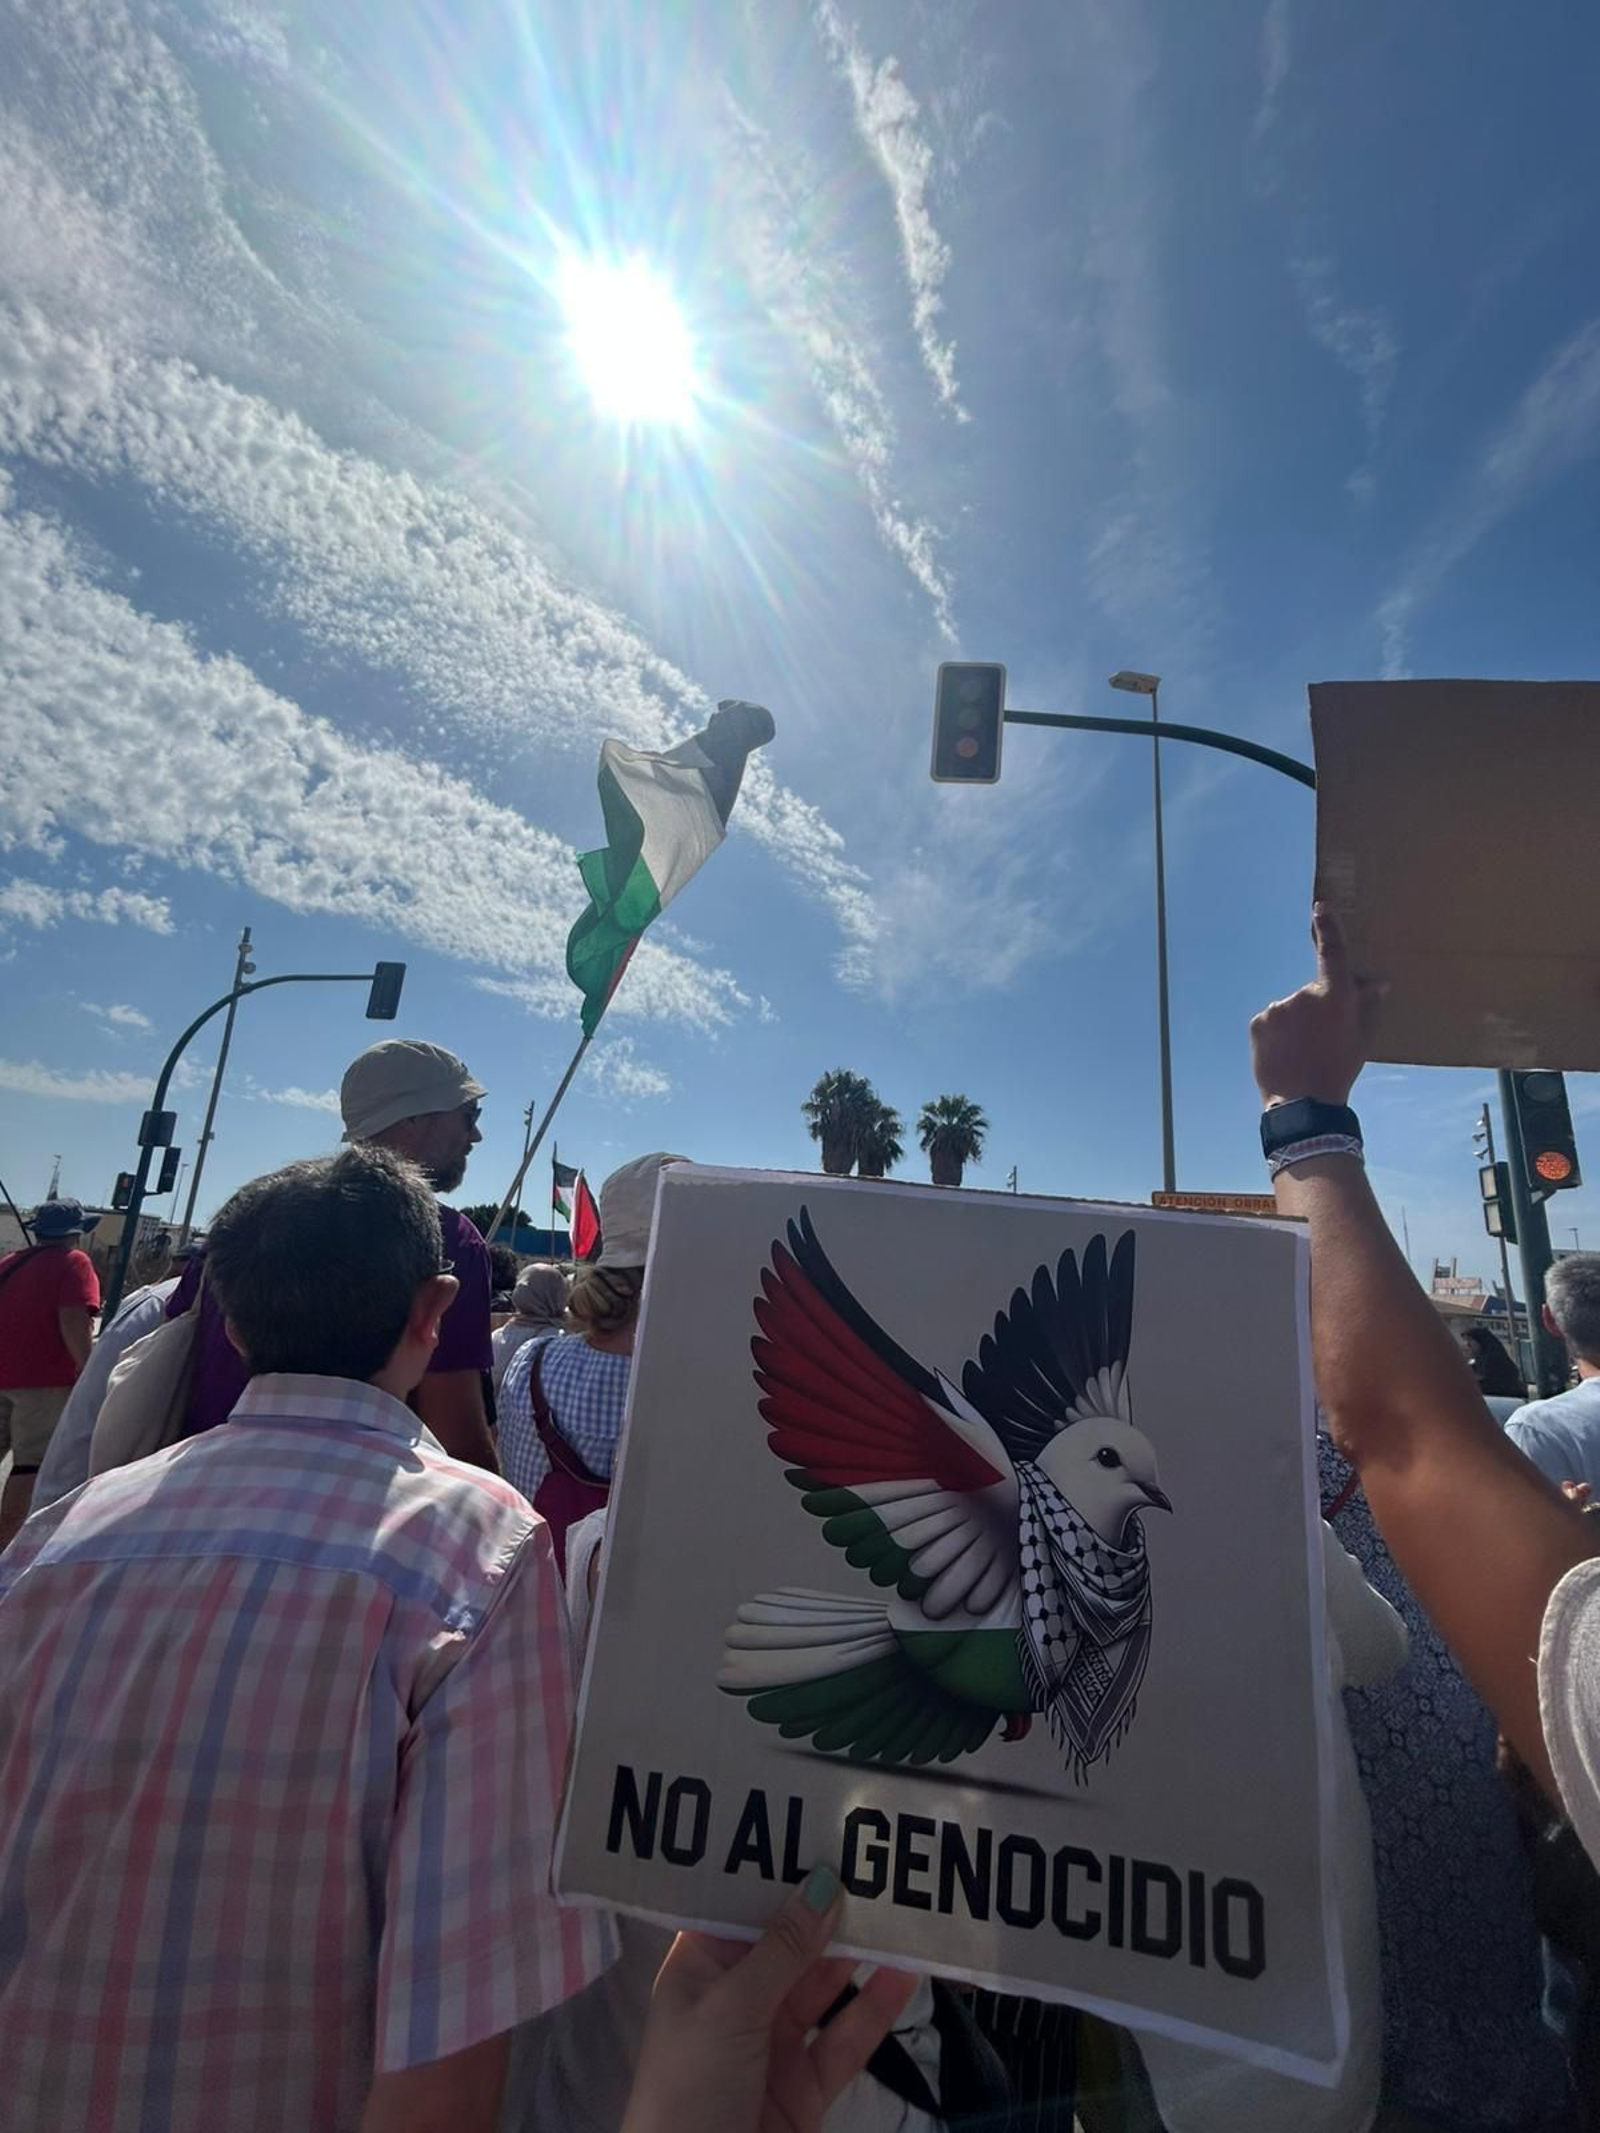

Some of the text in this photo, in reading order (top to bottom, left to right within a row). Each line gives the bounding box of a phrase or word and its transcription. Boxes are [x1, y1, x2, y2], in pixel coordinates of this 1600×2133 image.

[605, 1764, 1268, 1982] NO AL GENOCIDIO
